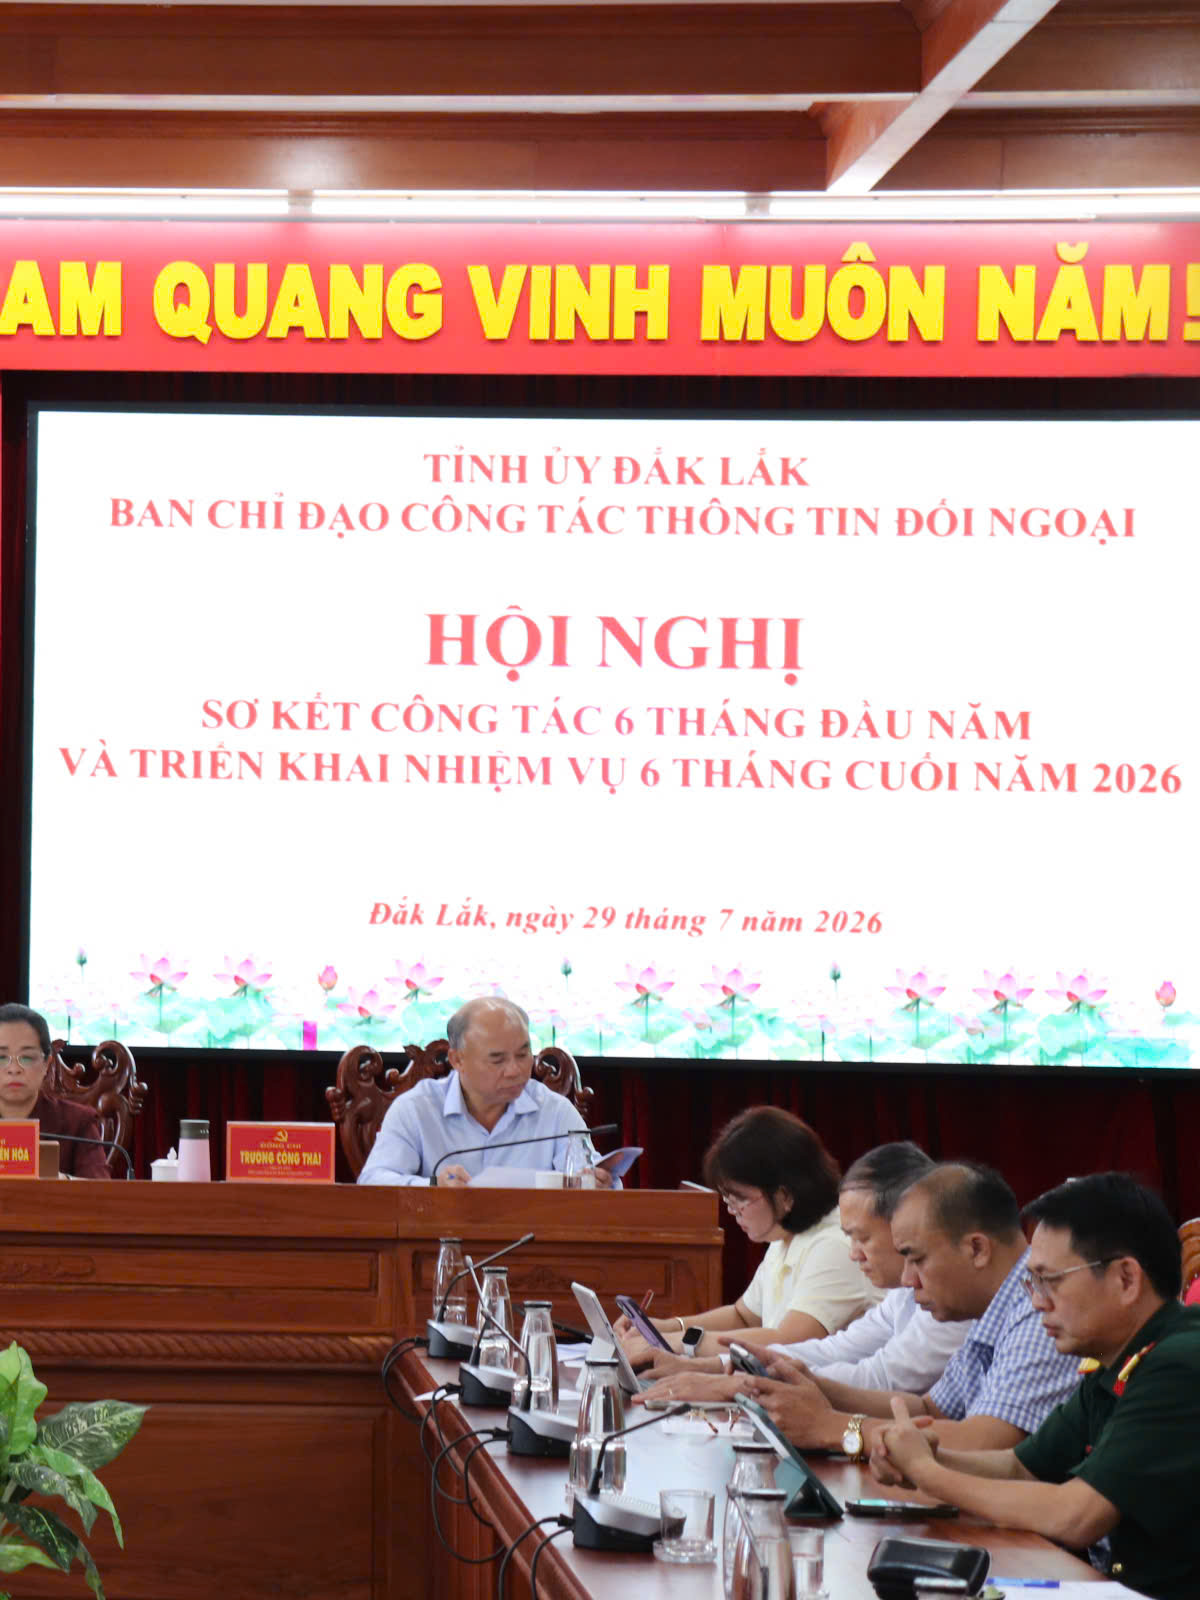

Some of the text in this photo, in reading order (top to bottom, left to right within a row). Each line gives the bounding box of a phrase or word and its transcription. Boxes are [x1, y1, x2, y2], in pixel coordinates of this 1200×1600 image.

[152, 260, 443, 345] QUANG
[467, 263, 670, 340] VINH
[700, 242, 947, 342] MUÔN
[423, 445, 809, 487] TỈNH ỦY ĐẮK LẮK
[110, 492, 1136, 546] BAN CHỈ ĐẠO CÔNG TÁC THÔNG TIN ĐỐI NGOẠI
[426, 604, 802, 687] HỘI NGHỊ
[201, 692, 1031, 741] SƠ KẾT CÔNG TÁC 6 THÁNG ĐẦU NĂM
[59, 739, 1182, 795] VÀ TRIỂN KHAI NHIỆM VỤ 6 THÁNG CUỐI NĂM 2026
[368, 896, 883, 937] Đắk Lắk, ngày 29 tháng 7 năm 2026
